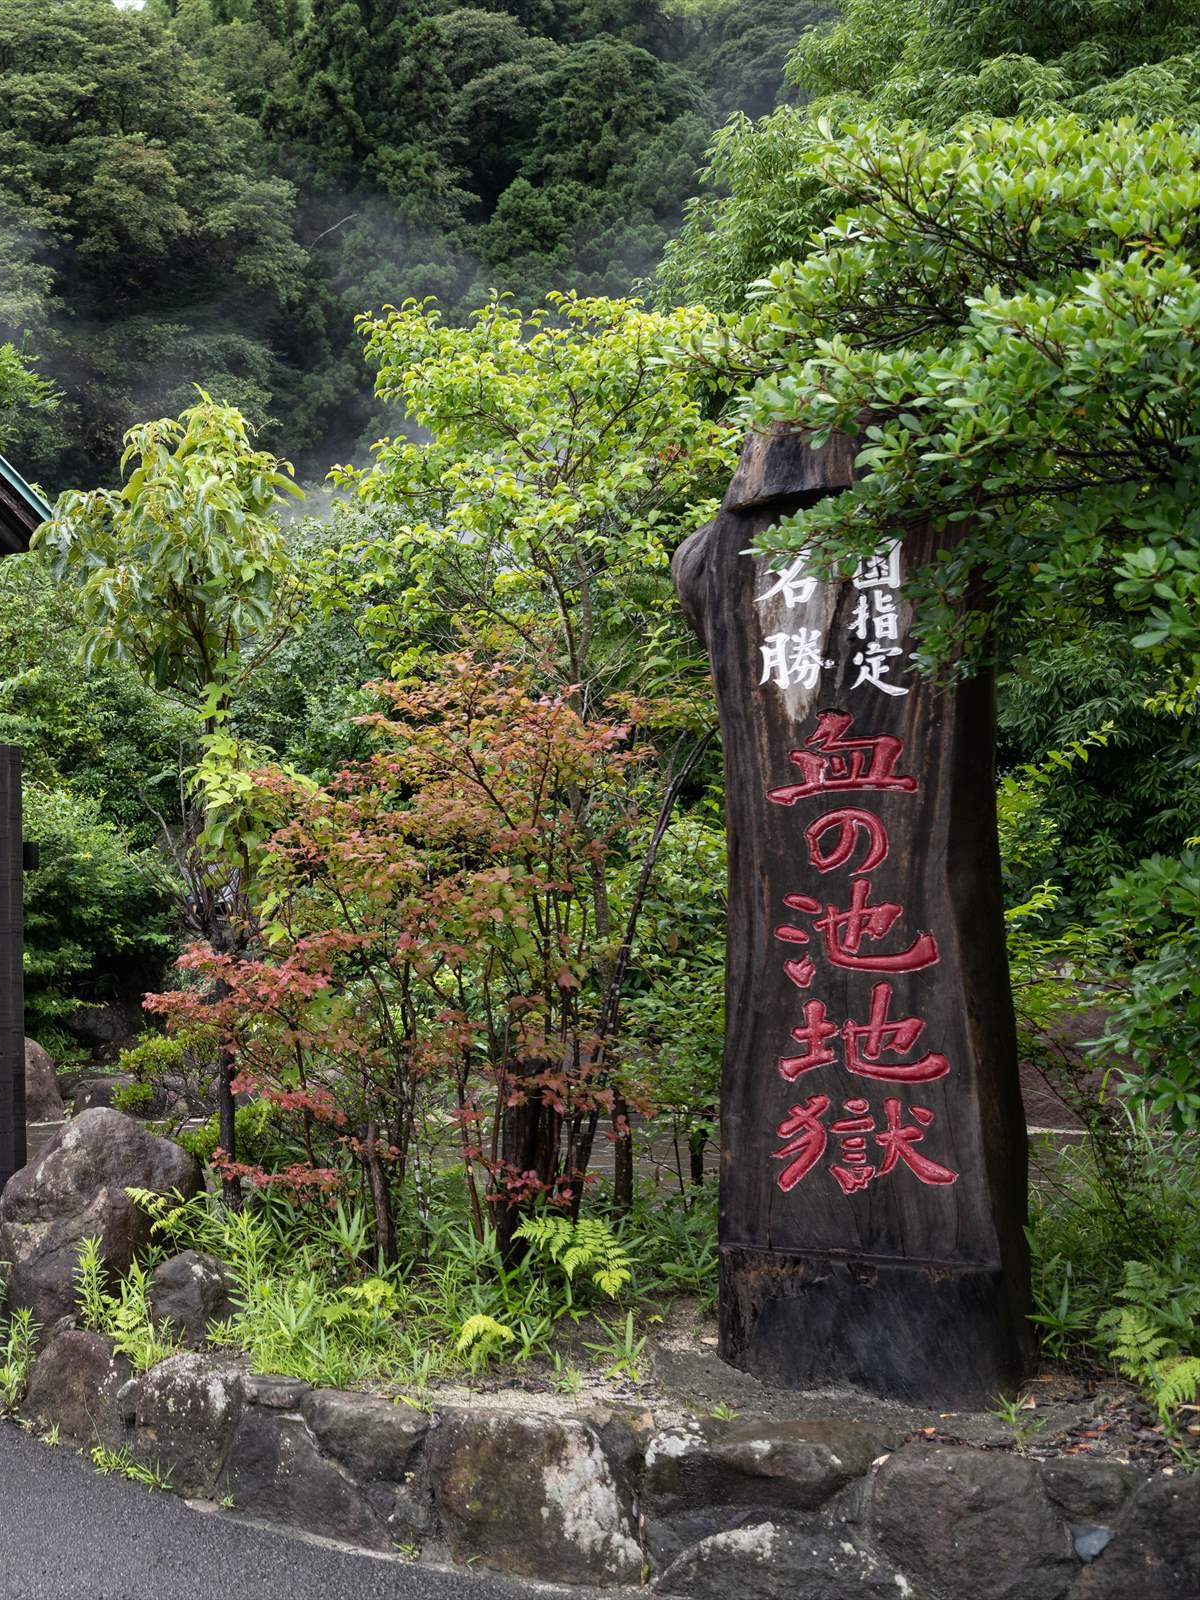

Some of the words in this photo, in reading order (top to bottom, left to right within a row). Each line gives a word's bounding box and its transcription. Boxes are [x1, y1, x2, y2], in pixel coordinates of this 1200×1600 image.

[752, 547, 825, 690] 名勝
[848, 534, 910, 697] 国指定
[766, 708, 960, 1195] 血の池地獄
